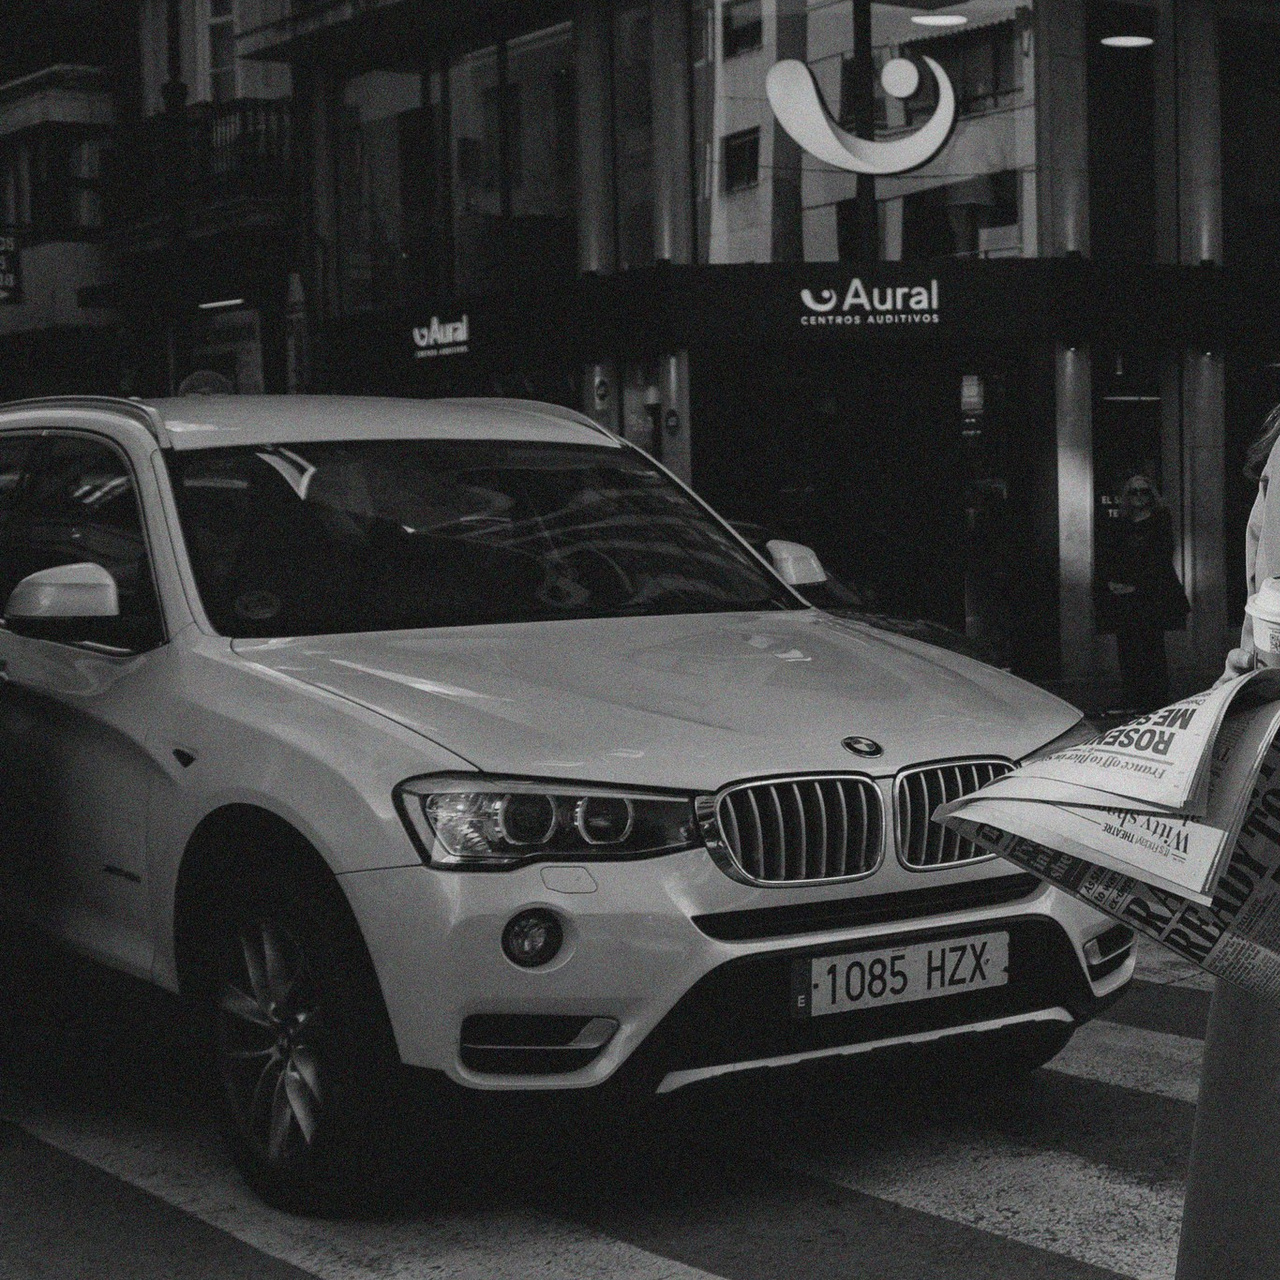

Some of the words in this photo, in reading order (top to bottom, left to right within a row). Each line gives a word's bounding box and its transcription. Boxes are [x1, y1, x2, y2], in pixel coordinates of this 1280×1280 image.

[842, 278, 938, 311] Aural
[428, 313, 470, 346] Aural
[800, 315, 861, 326] CENTROS
[866, 313, 941, 324] AUDITIVOS
[1081, 728, 1176, 756] ROSEN
[1089, 754, 1100, 766] to
[1098, 756, 1121, 772] off
[1120, 761, 1166, 780] France
[1102, 822, 1136, 844] THEATRE
[1140, 817, 1190, 854] Witty
[1053, 854, 1073, 880] she
[1083, 880, 1096, 894] As
[1093, 890, 1106, 903] to
[1163, 841, 1271, 965] READY
[827, 954, 908, 1005] 1085
[926, 941, 988, 990] HZX
[797, 995, 806, 1007] E
